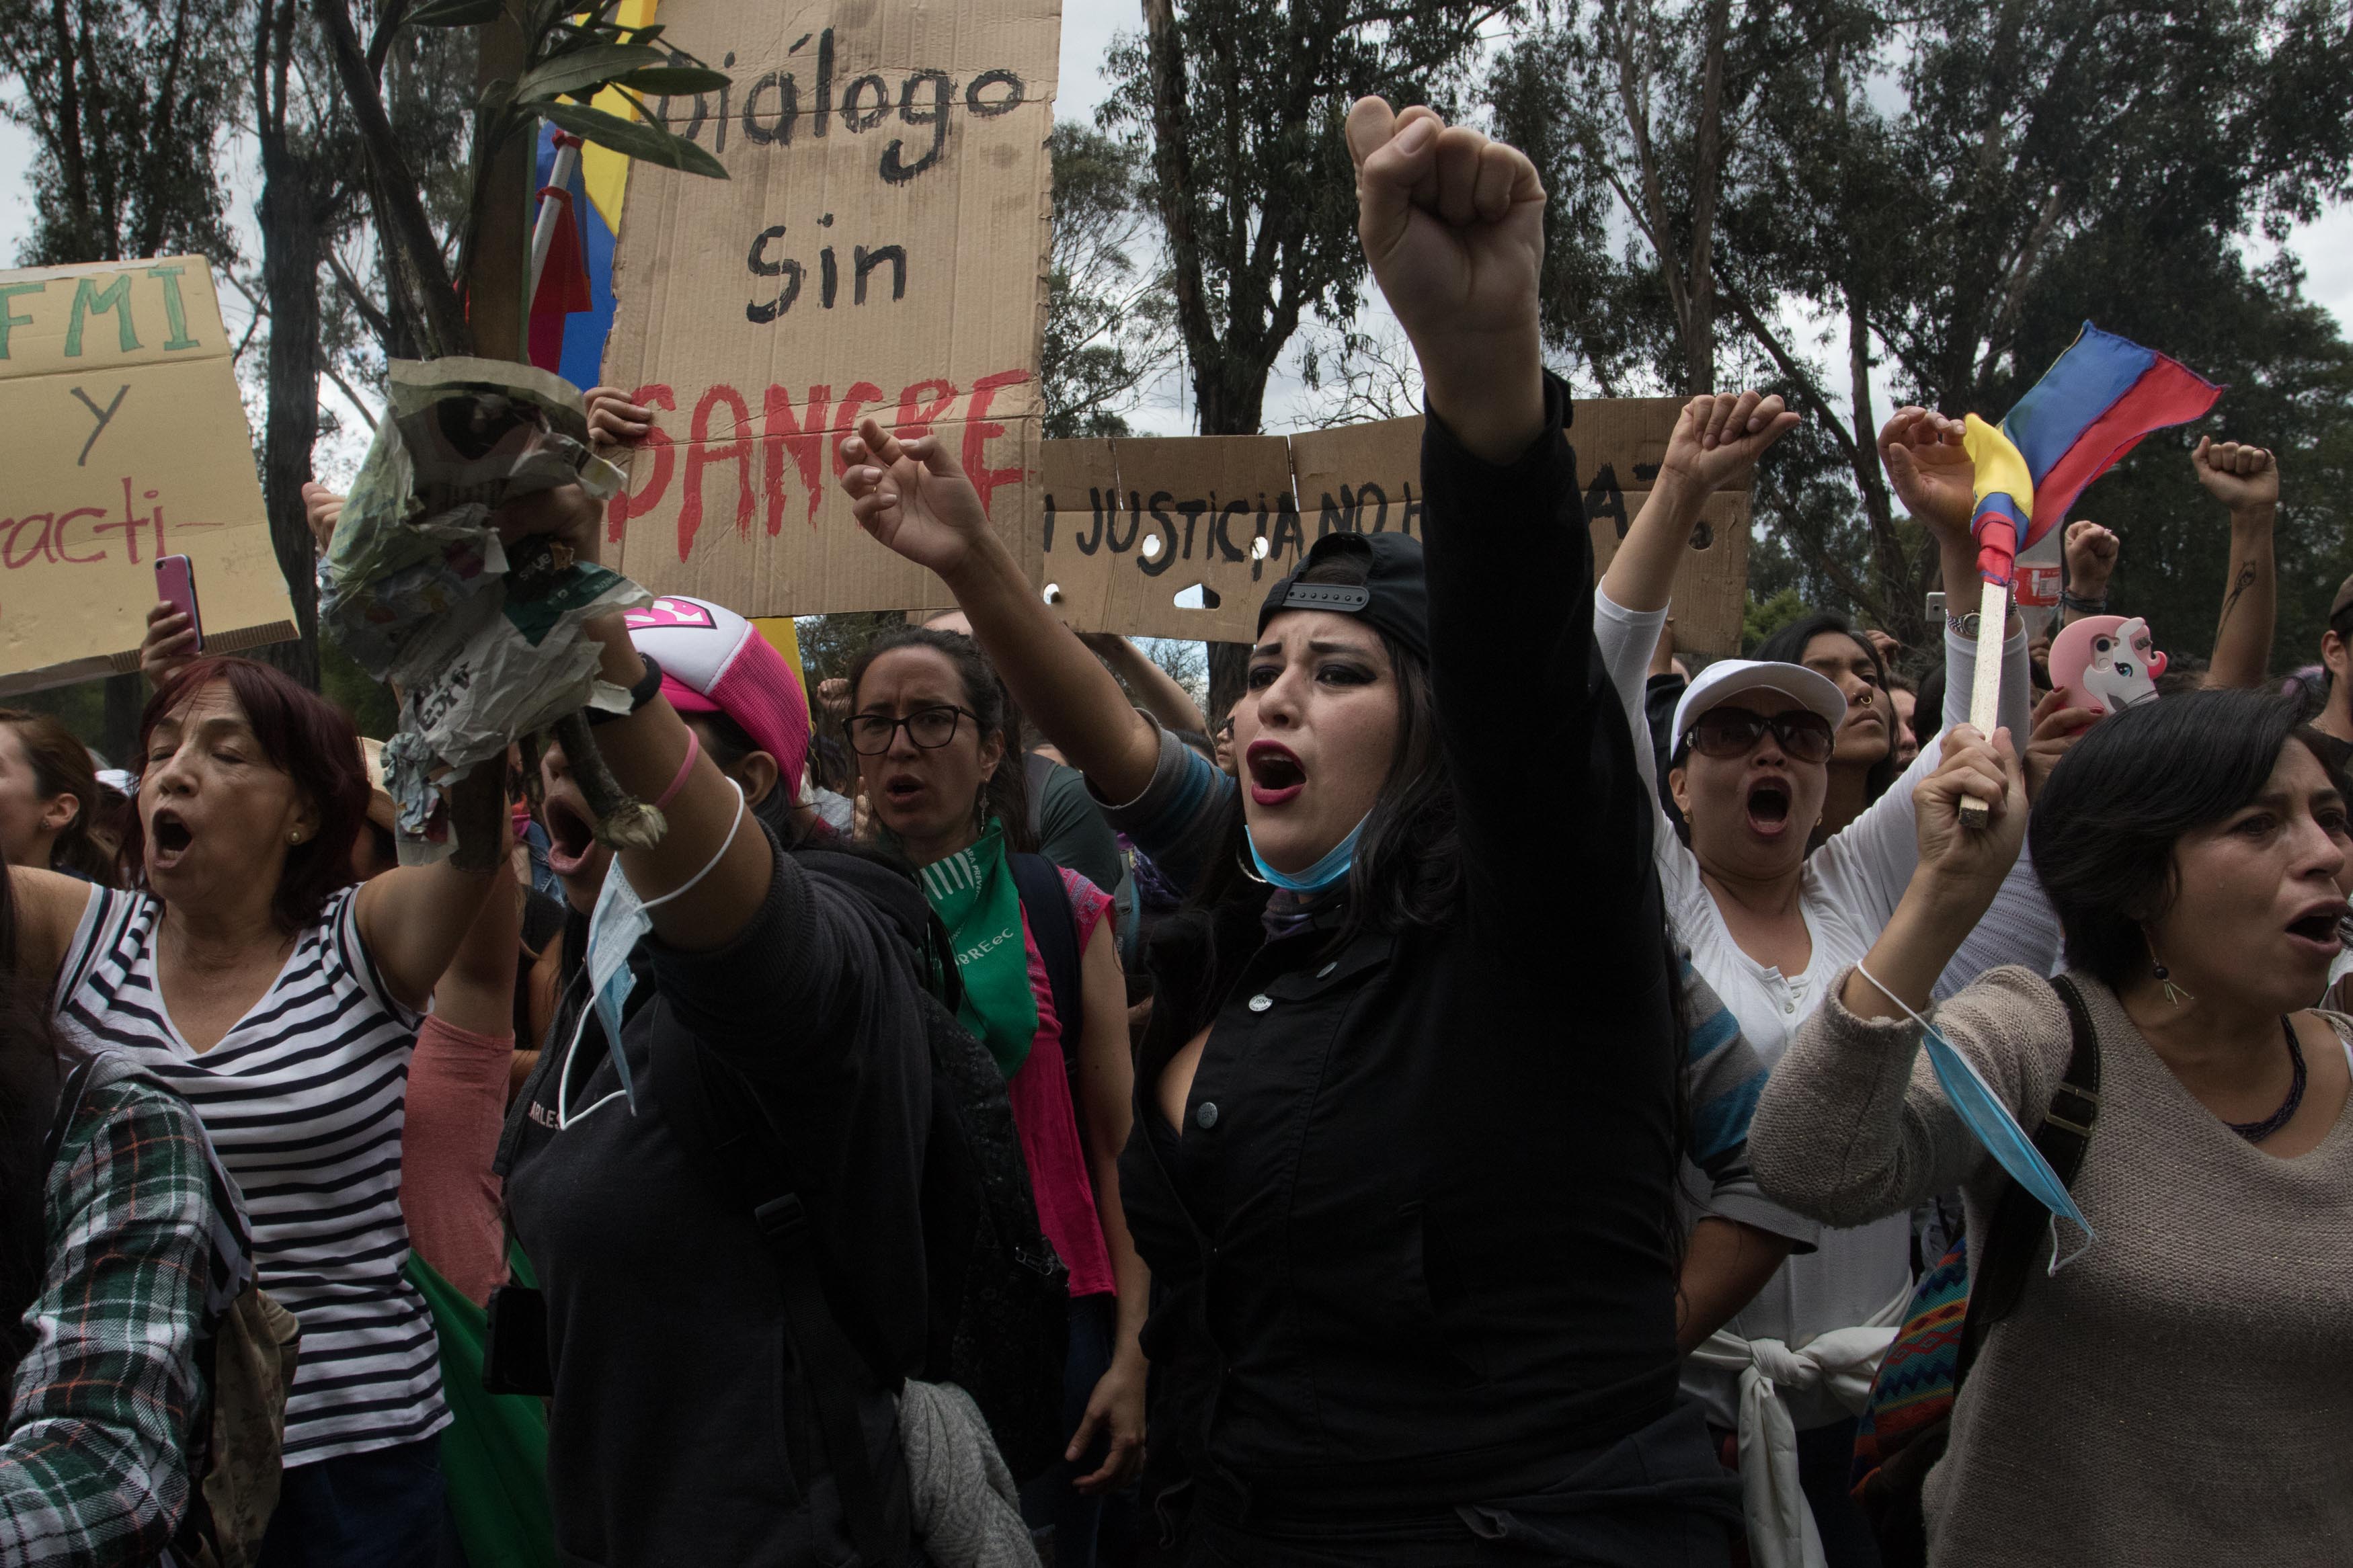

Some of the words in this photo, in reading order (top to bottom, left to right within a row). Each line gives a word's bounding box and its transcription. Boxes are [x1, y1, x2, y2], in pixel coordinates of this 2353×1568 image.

[0, 266, 200, 360] FMI
[0, 477, 224, 569] acti-
[1076, 487, 1304, 581] JUSTICIA
